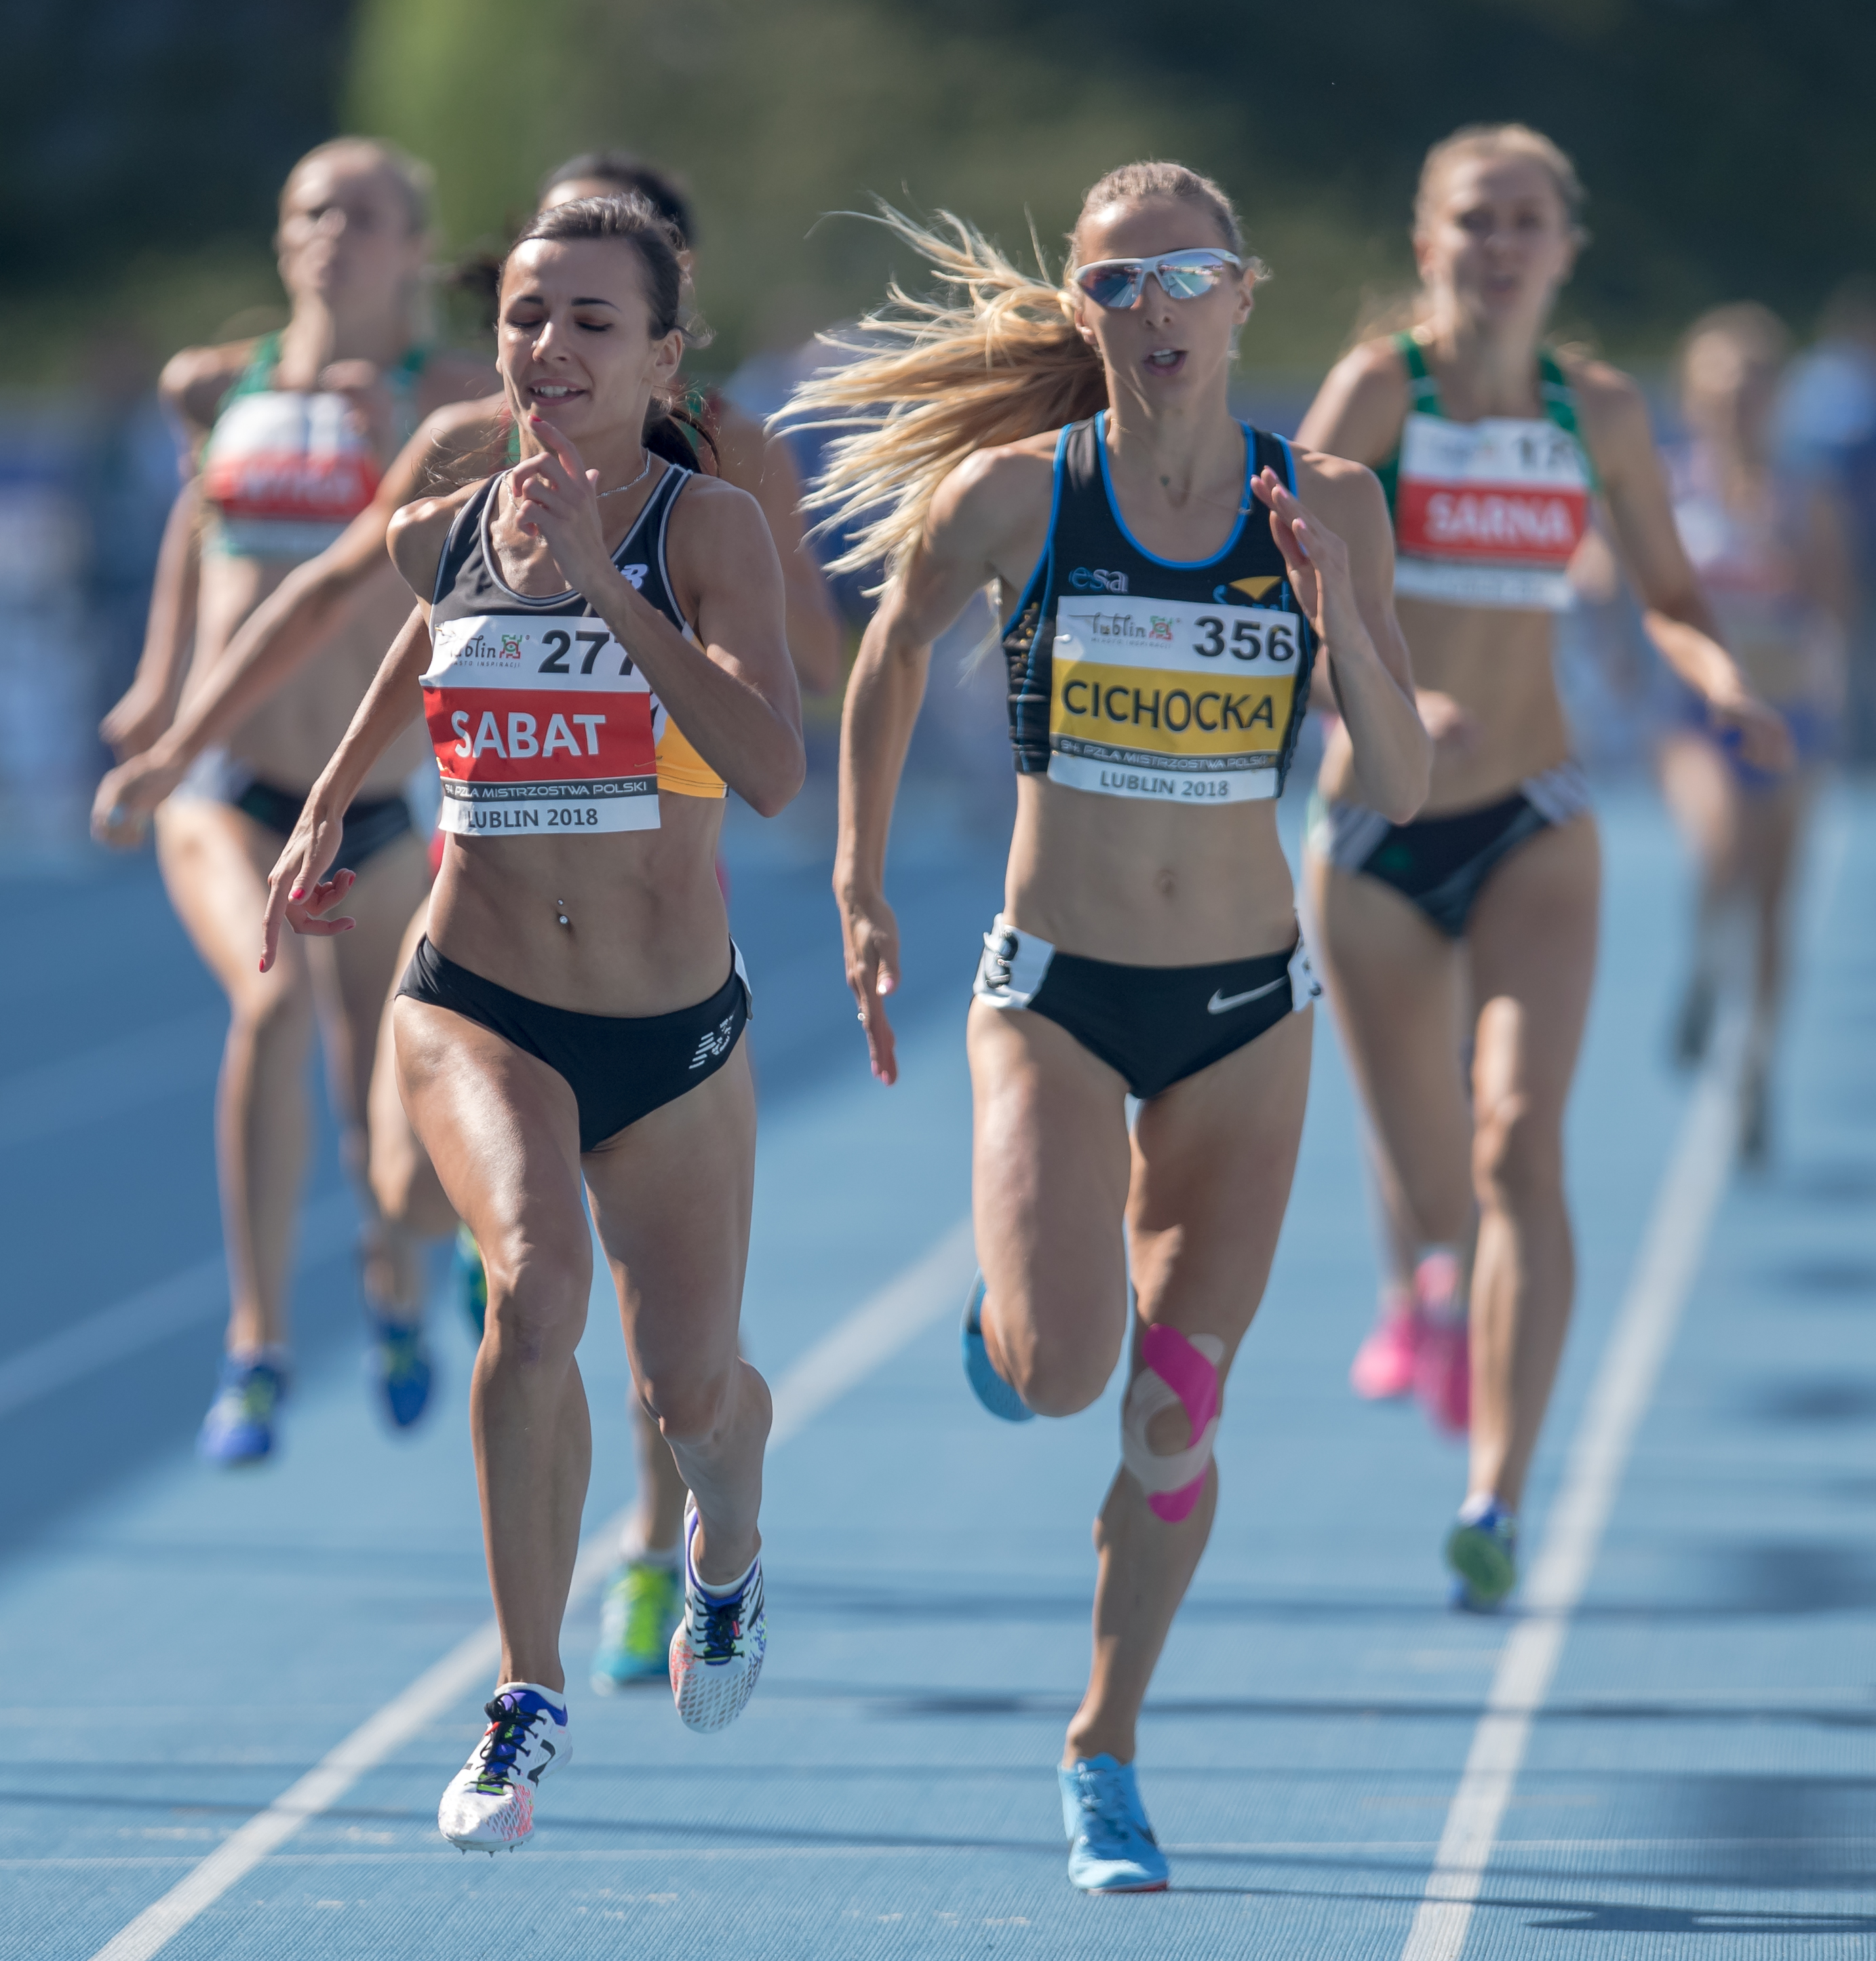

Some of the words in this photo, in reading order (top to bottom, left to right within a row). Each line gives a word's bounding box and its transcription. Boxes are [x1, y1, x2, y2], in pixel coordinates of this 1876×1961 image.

[1427, 492, 1573, 545] SARNA
[1069, 567, 1129, 594] esa
[1093, 612, 1146, 638] lublin
[1192, 615, 1295, 661] 356
[477, 661, 521, 669] INSPIRACJI
[1061, 680, 1273, 732] CICHOCKA
[451, 710, 606, 758] SABAT
[1083, 745, 1122, 760] PZLA
[1122, 752, 1226, 769] MISTRZOSTWA
[1228, 755, 1268, 767] POLSKI
[455, 785, 480, 798] PZLA
[482, 785, 589, 798] MISTRZOSTWA
[593, 781, 646, 794] POLSKI
[1100, 771, 1174, 794] LUBLIN
[1181, 779, 1230, 796] 2018
[468, 809, 539, 828] LUBLIN
[547, 808, 598, 826] 2018
